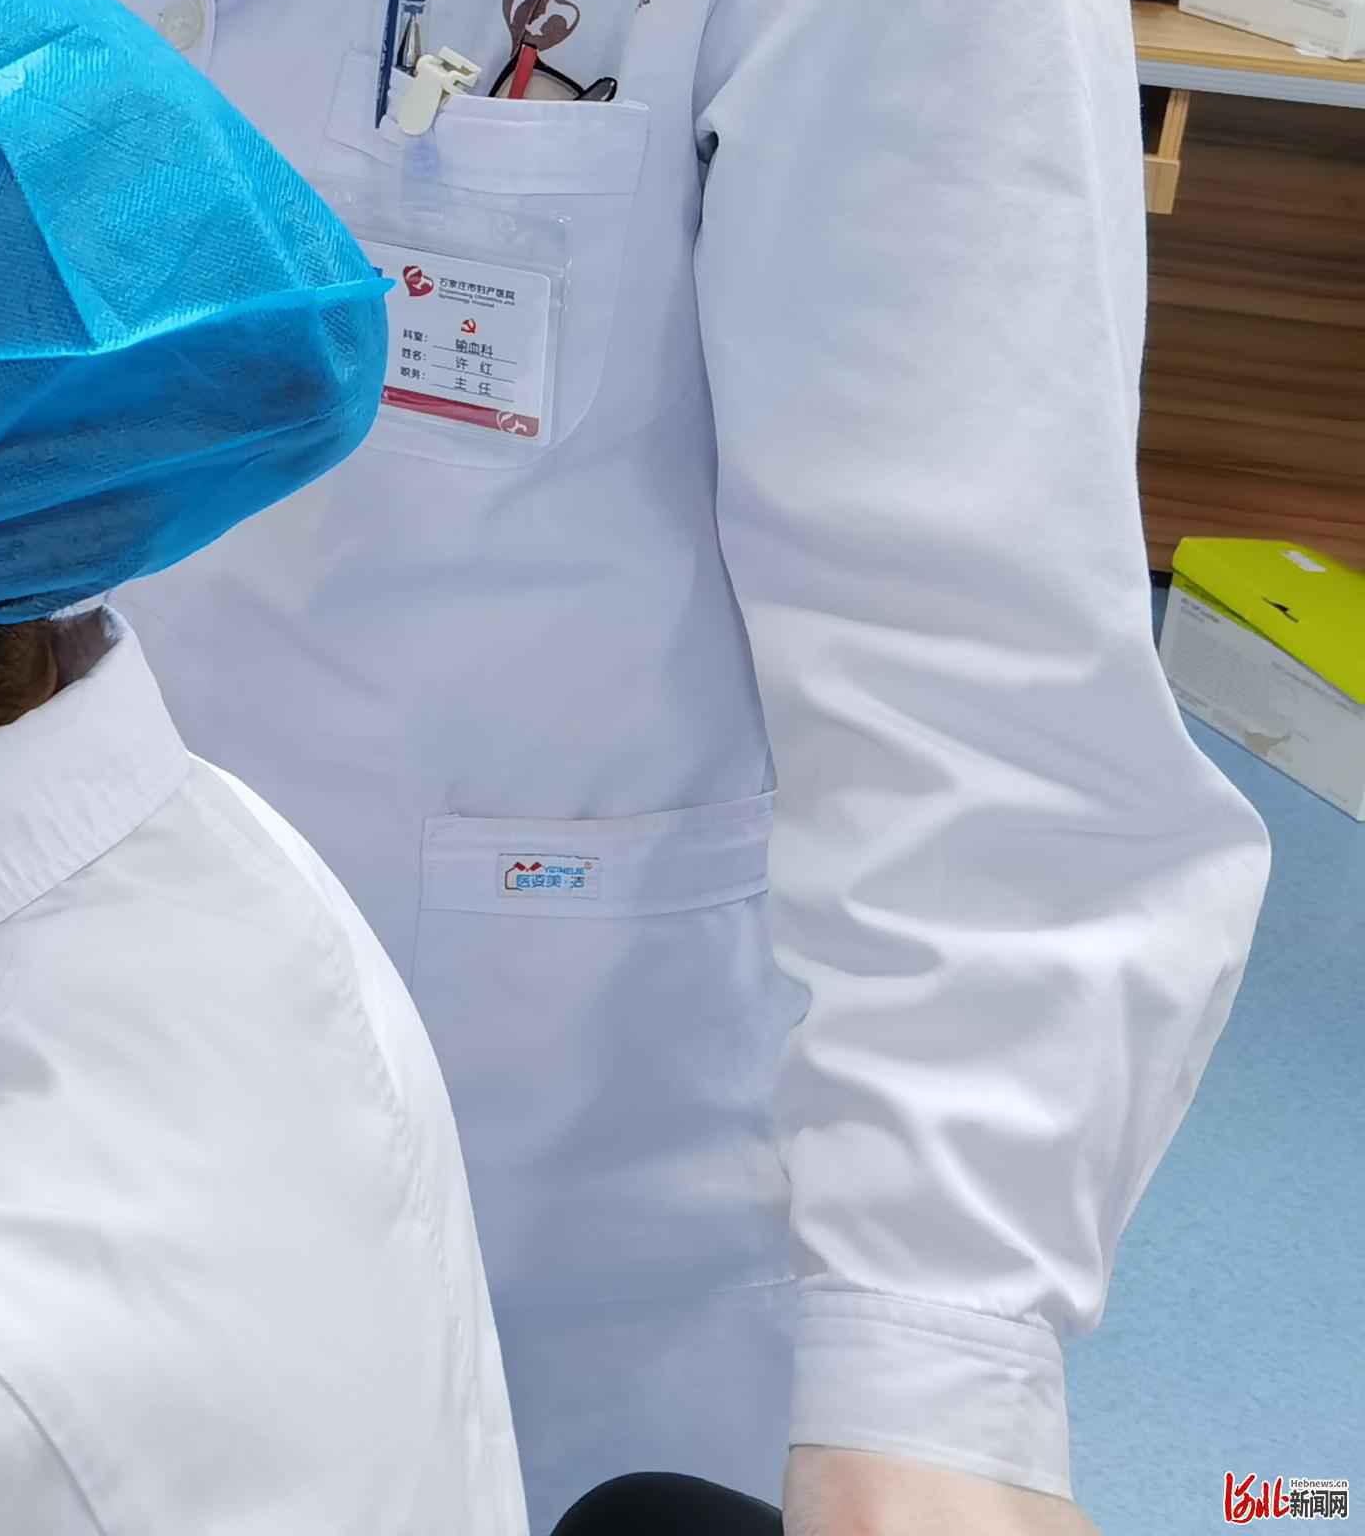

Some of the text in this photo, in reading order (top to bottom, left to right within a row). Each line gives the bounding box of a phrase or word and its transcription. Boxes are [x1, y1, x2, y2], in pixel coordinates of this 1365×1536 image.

[402, 328, 494, 358] 科室: 输血科
[401, 348, 427, 362] 姓名:
[400, 366, 426, 381] 职务:
